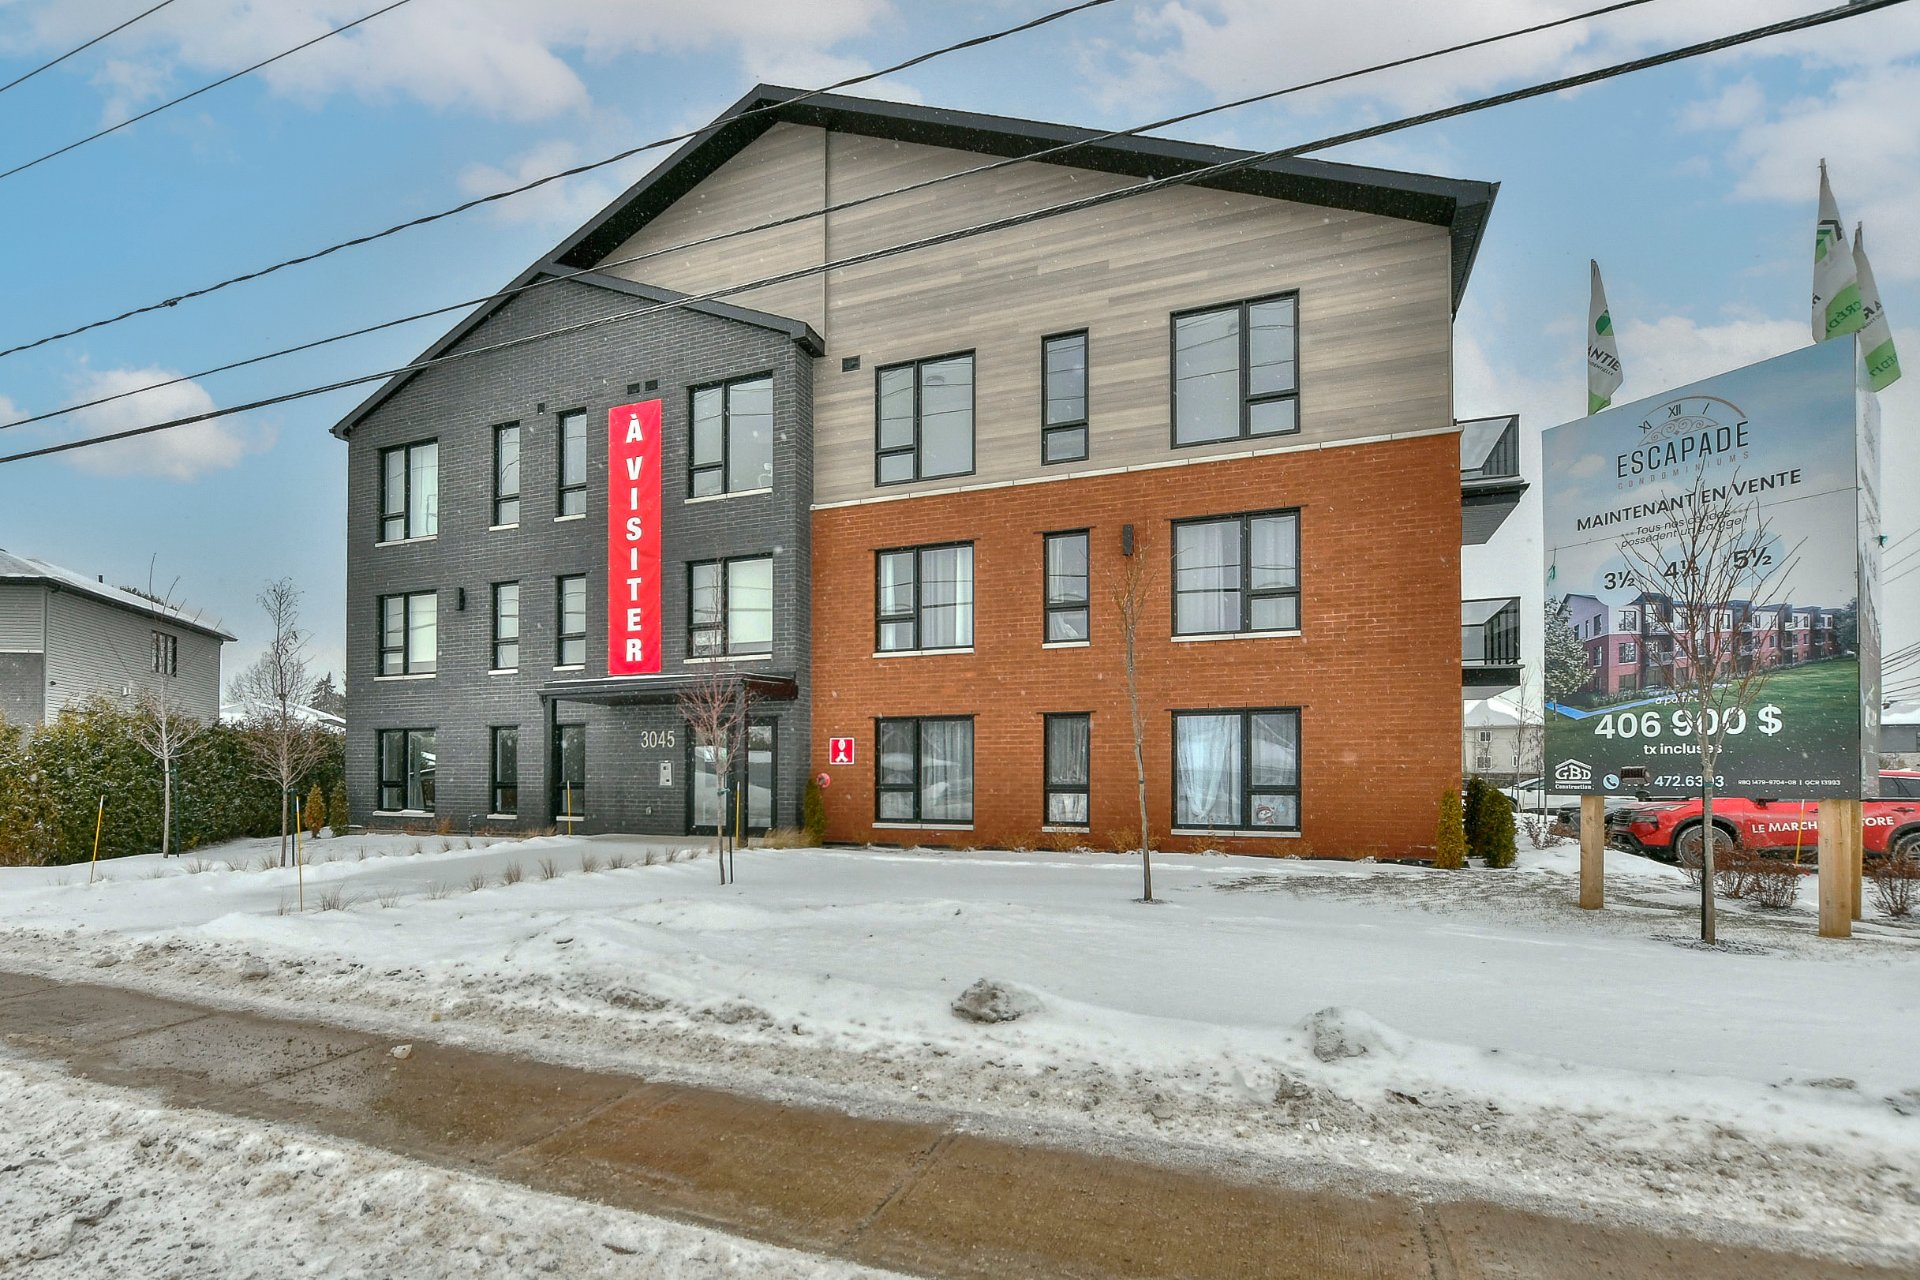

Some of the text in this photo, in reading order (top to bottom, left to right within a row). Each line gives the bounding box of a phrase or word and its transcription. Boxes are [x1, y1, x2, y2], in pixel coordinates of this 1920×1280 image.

[1617, 420, 1749, 478] ESCAPADE
[1618, 451, 1749, 490] CONDOMINIUMS
[1577, 468, 1801, 531] MAINTENANT EN VENTE
[1637, 522, 1660, 536] Tous
[1664, 519, 1685, 530] nos
[625, 414, 643, 662] À VISITER
[1594, 703, 1783, 739] 406 900 $
[641, 731, 675, 748] 3045
[1643, 743, 1723, 755] tx incluses
[1555, 764, 1591, 780] GBD
[1654, 775, 1725, 787] 472.633
[1751, 824, 1765, 834] LE
[1768, 821, 1818, 833] MARCH
